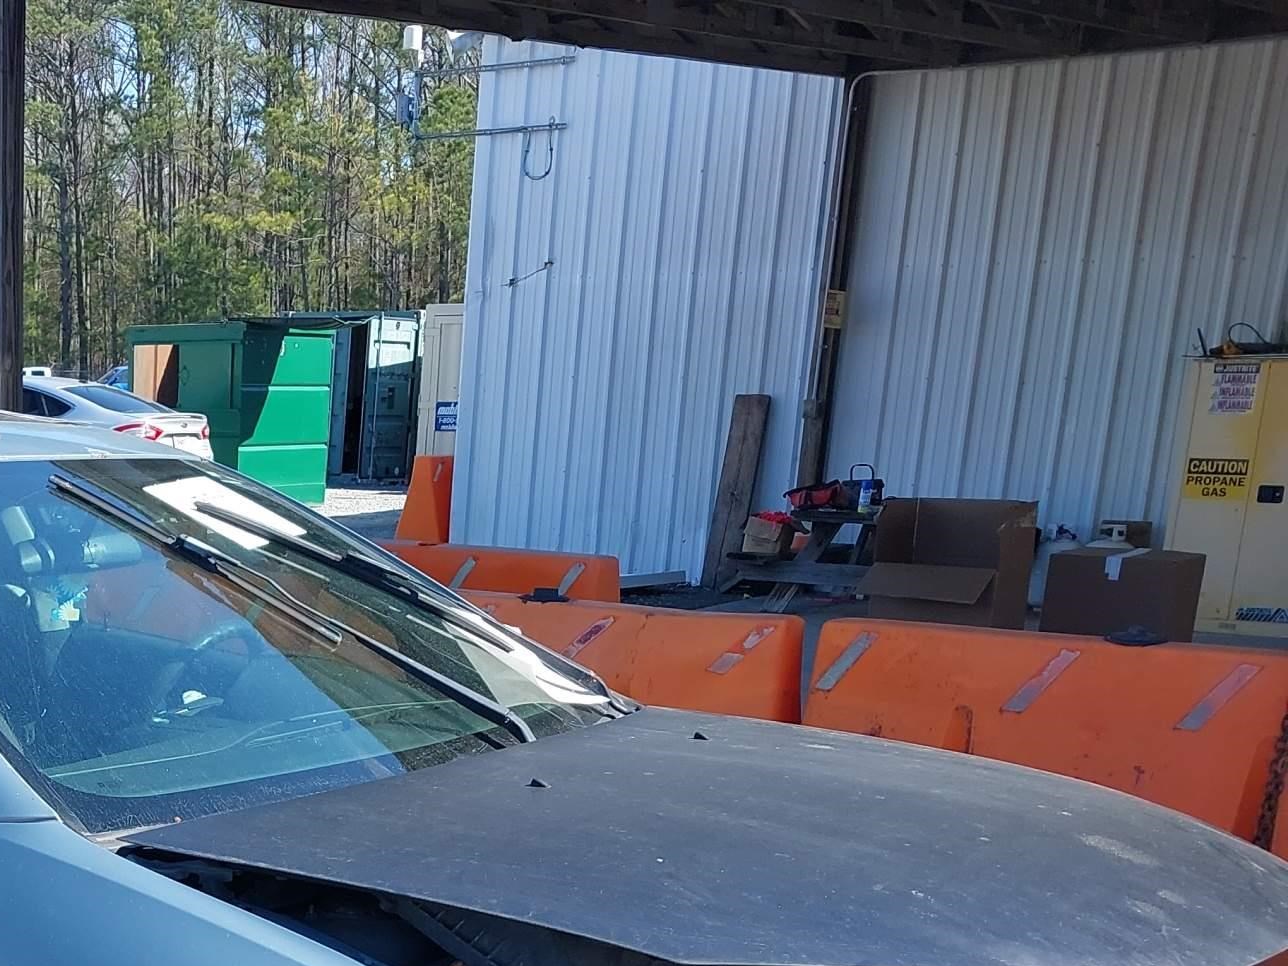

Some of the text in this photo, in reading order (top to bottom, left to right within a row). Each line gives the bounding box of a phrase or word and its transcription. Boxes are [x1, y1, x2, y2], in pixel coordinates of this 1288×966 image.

[1190, 460, 1248, 474] CAUTION
[1185, 475, 1247, 487] PROPANE
[1201, 486, 1228, 497] GAS
